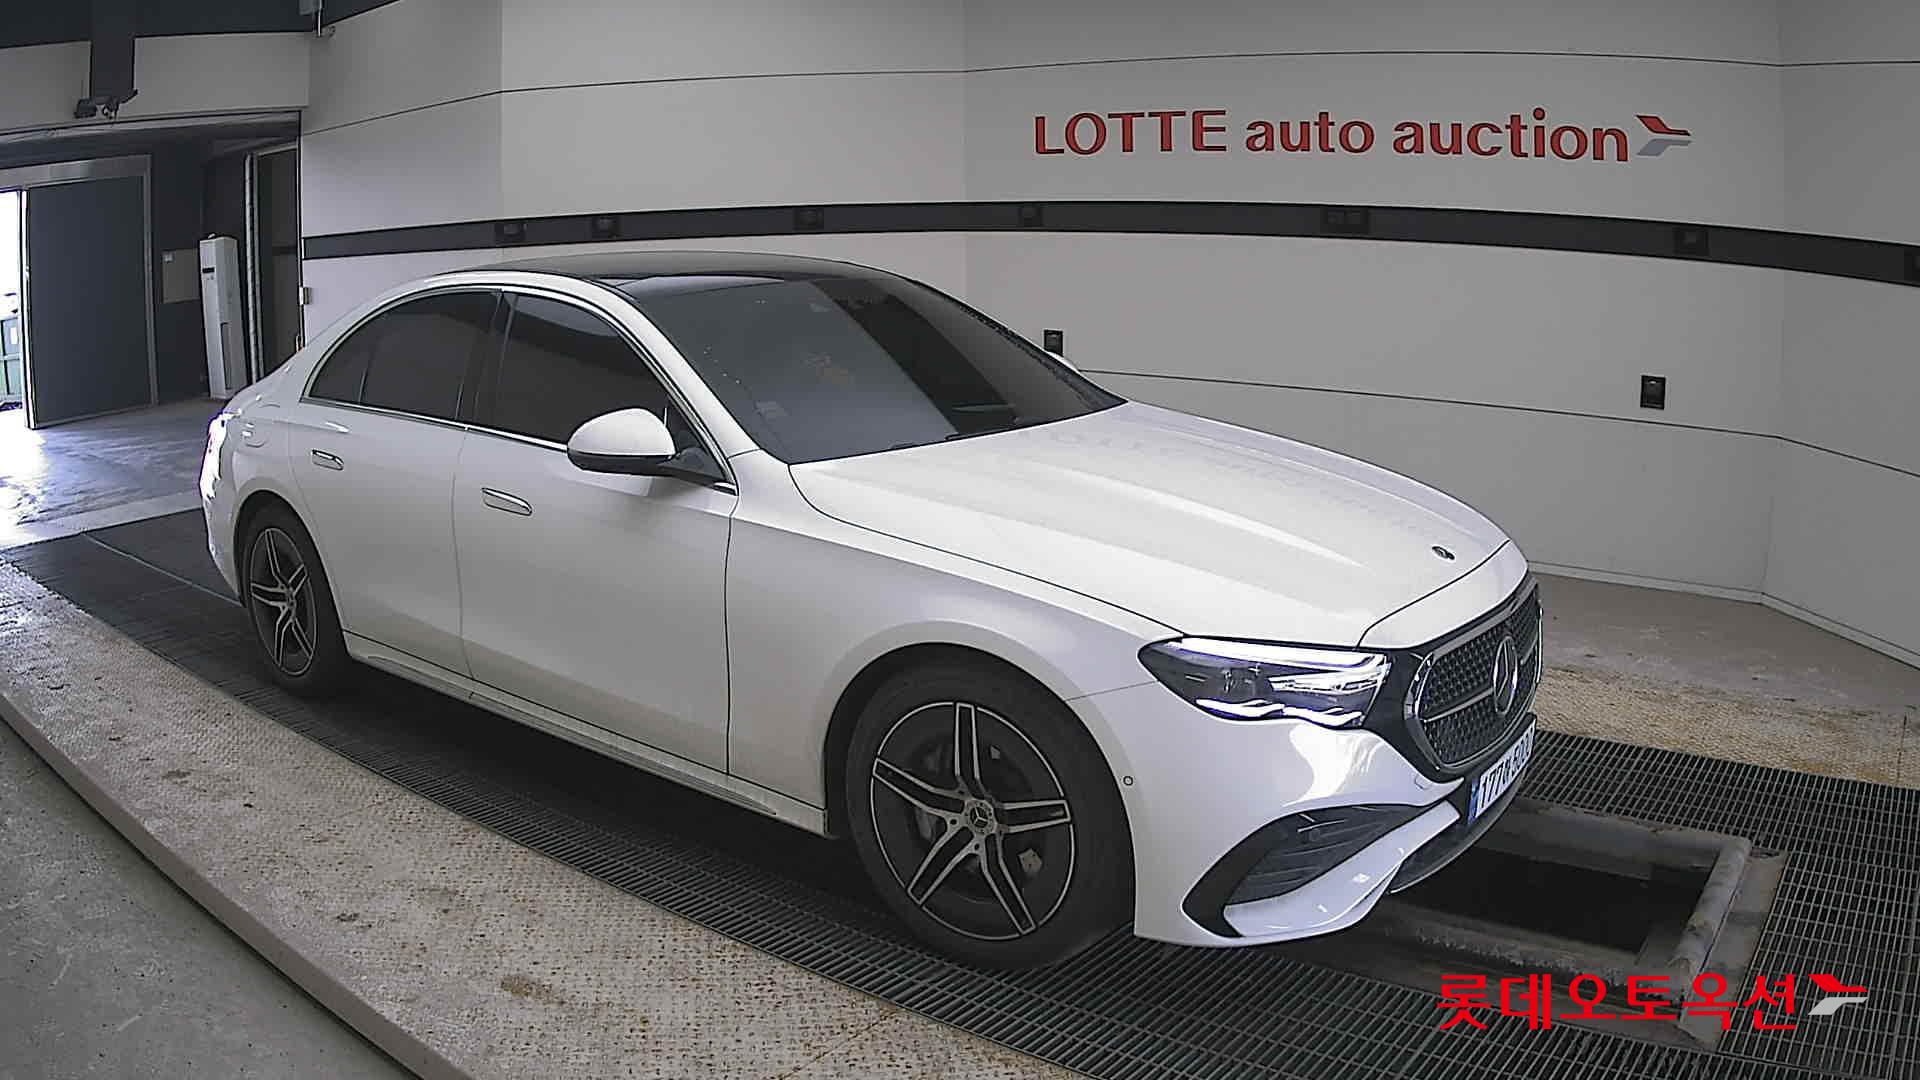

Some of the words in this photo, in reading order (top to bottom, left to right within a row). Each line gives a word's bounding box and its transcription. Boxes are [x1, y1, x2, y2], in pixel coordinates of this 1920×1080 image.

[1035, 110, 1228, 155] LOTTE
[1246, 112, 1376, 155] auto
[1393, 107, 1630, 162] auction
